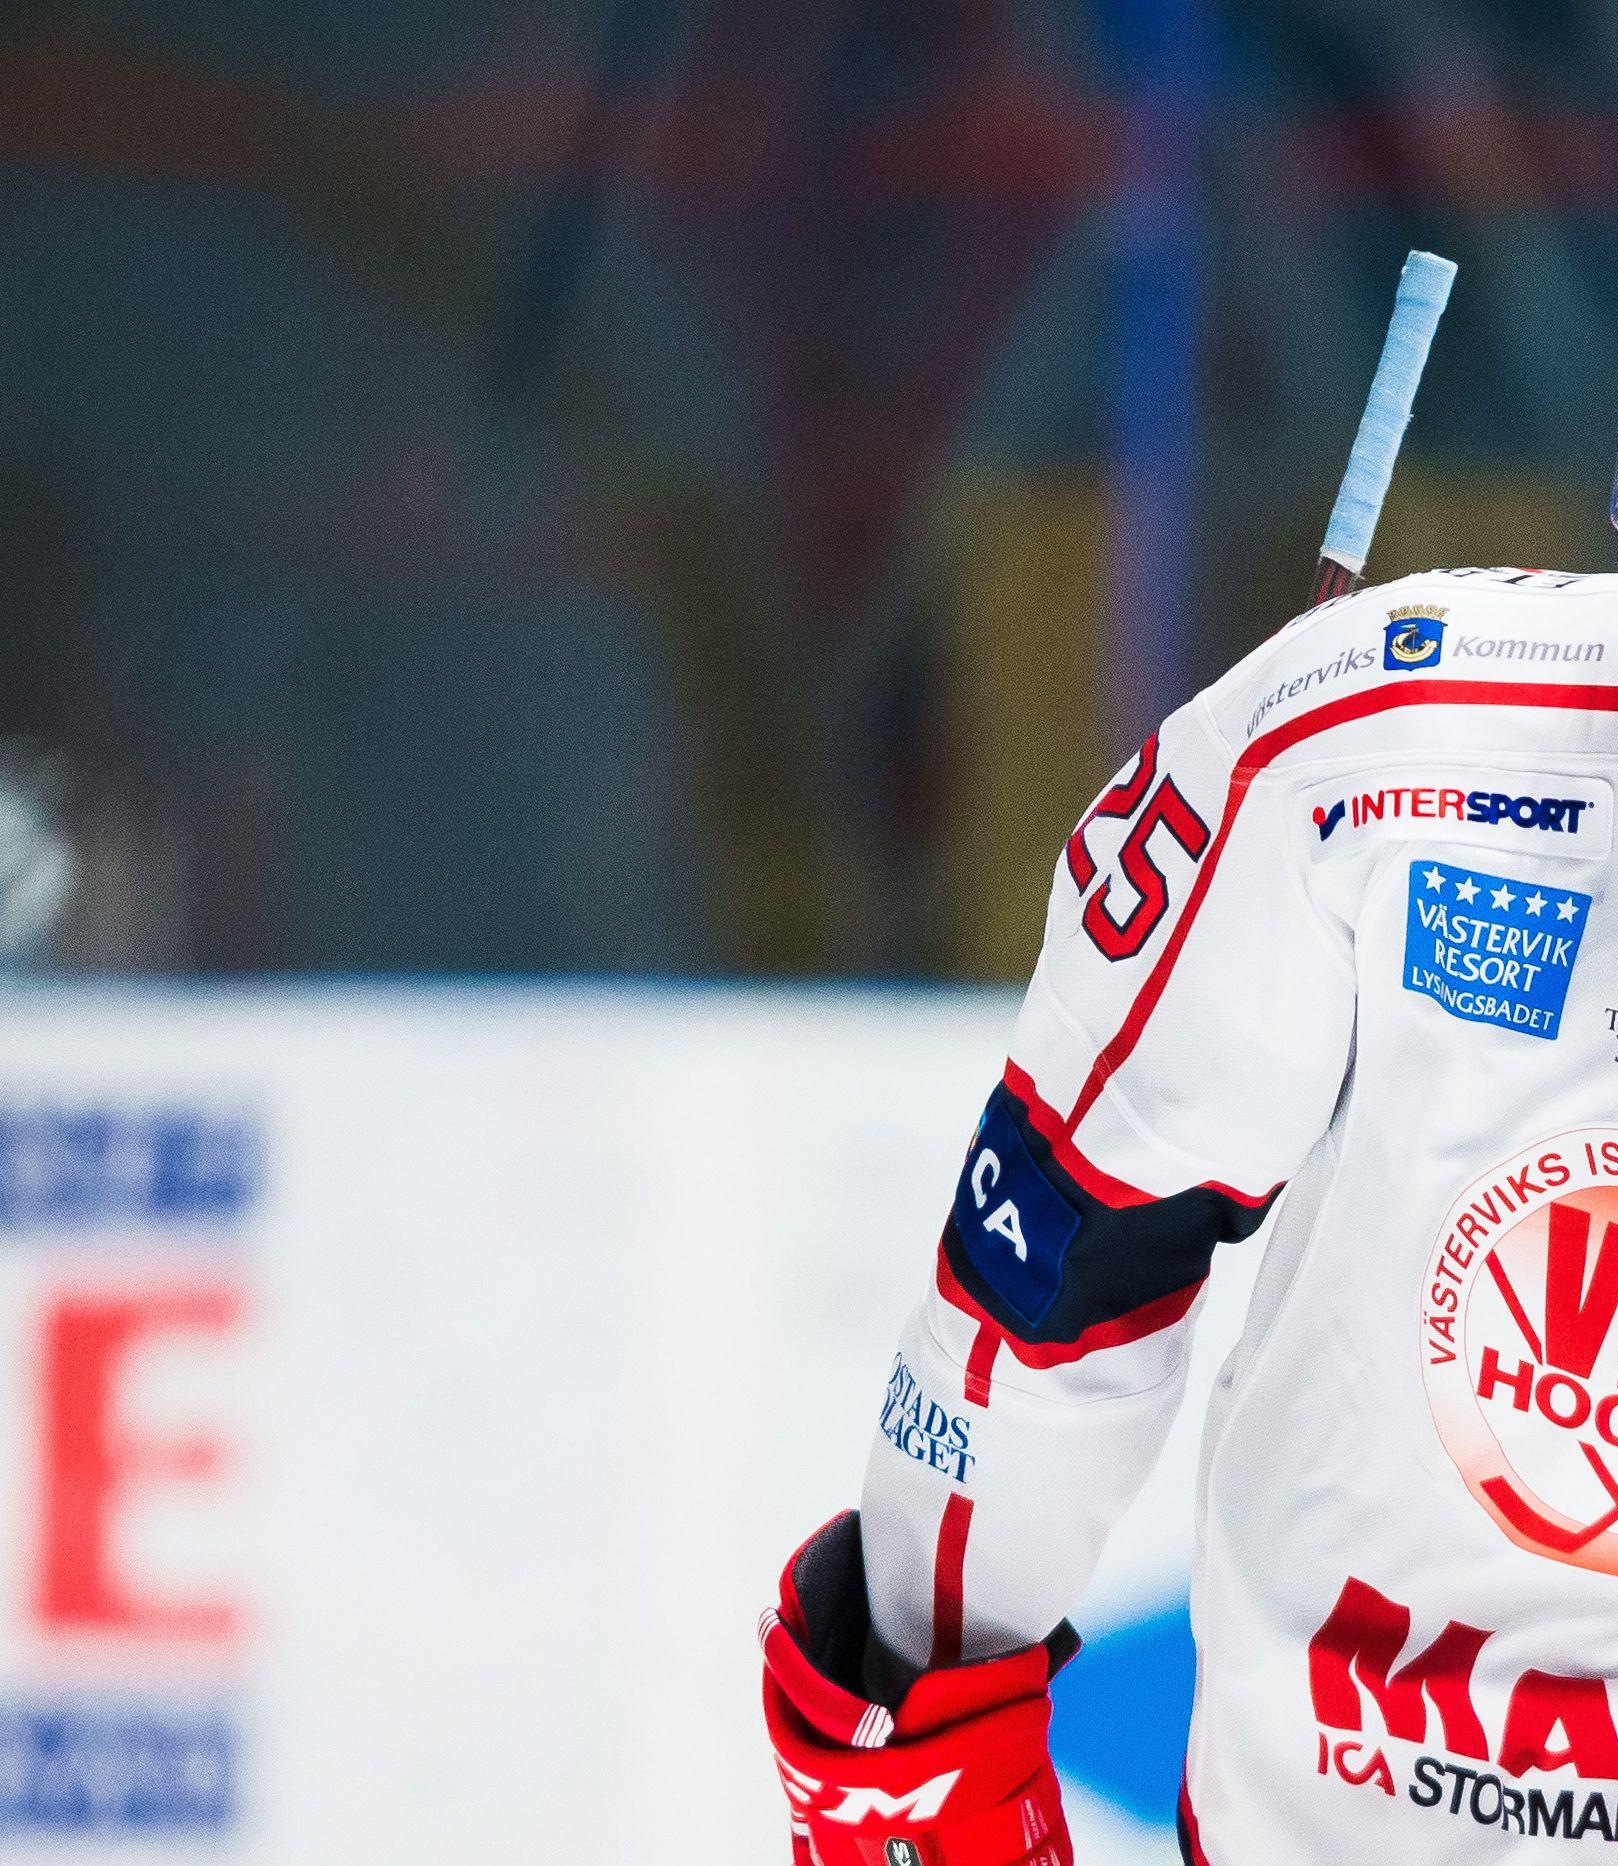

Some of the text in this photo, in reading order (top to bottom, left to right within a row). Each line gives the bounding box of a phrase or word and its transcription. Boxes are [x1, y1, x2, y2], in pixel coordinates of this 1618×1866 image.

[1452, 635, 1605, 663] Kommun
[1352, 787, 1588, 834] INTERSPORT
[1066, 731, 1211, 963] 25
[1416, 897, 1574, 968] VÄSTERVIK
[1434, 937, 1542, 993] RESORT
[1411, 966, 1555, 1031] LYSINGSBADET
[1423, 1151, 1572, 1365] VÄSTERVIKS
[1316, 1731, 1397, 1797] ICA
